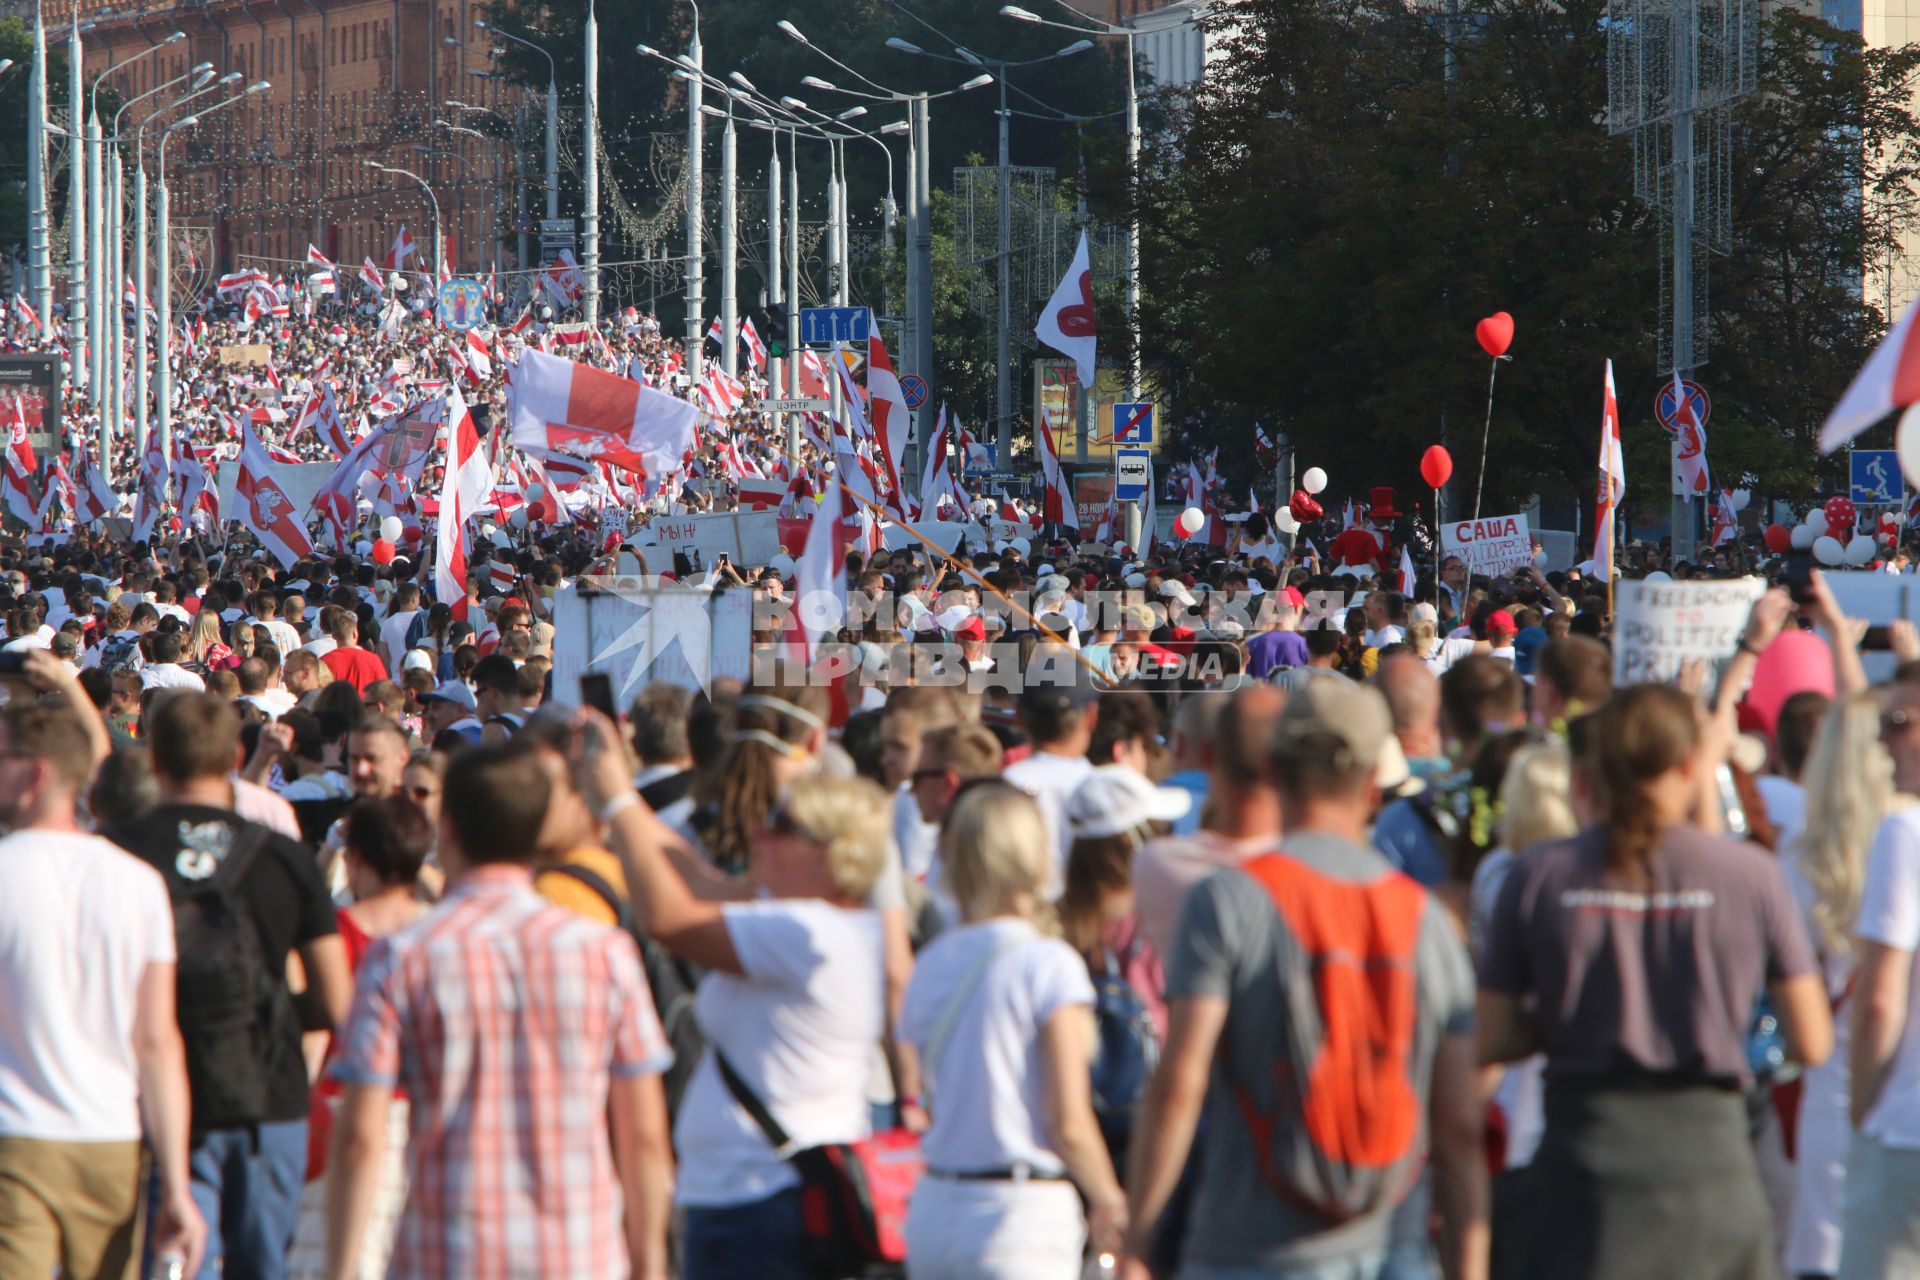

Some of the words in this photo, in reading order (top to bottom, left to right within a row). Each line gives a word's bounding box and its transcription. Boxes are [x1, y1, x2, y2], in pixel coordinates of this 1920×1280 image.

[776, 402, 809, 410] ЦЭНТР
[1079, 503, 1088, 514] 28
[660, 524, 680, 540] МЫ
[1005, 525, 1017, 537] ЗА
[1455, 518, 1518, 543] САША
[1633, 585, 1752, 609] FREEDOM
[1623, 620, 1735, 648] POLITIC
